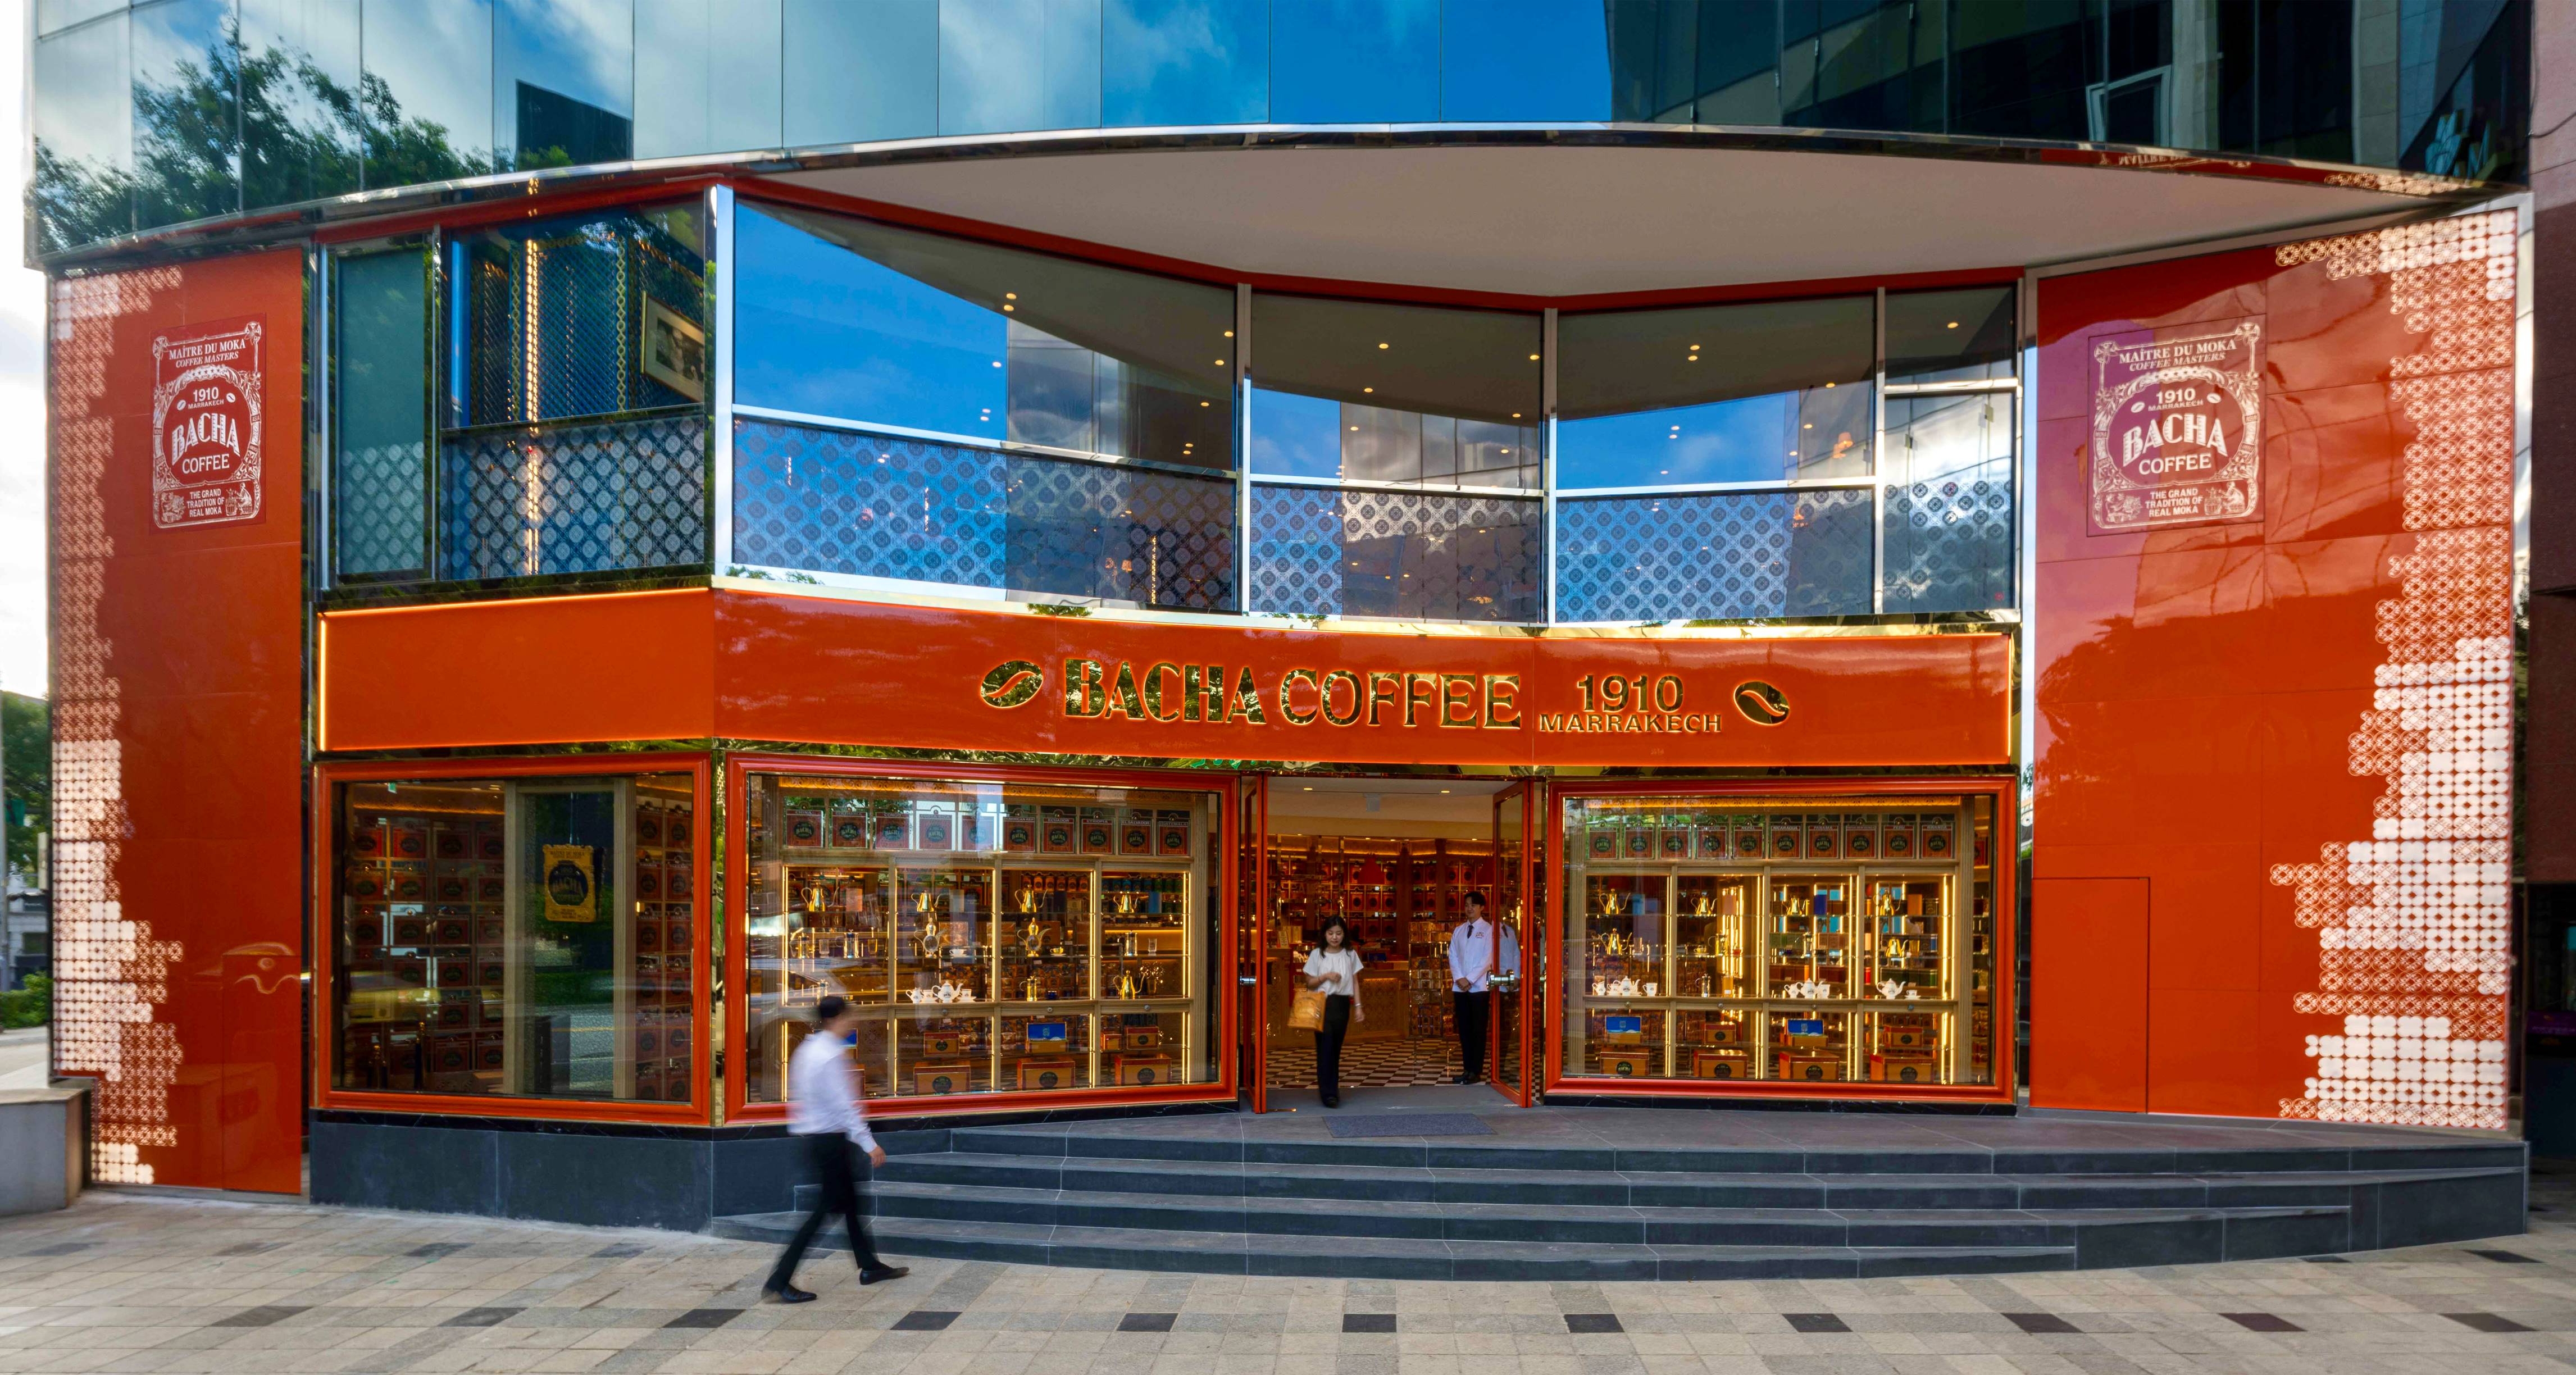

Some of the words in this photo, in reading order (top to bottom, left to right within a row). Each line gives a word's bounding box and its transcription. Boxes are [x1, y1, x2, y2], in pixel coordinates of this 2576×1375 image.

[205, 342, 217, 354] DU
[220, 339, 246, 352] MOKA
[2174, 344, 2193, 356] DU
[2197, 339, 2237, 354] MOKA
[176, 356, 203, 368] COFFEE
[203, 352, 239, 366] MASTERS
[2129, 359, 2171, 371] COFFEE
[2172, 352, 2226, 366] MASTERS
[193, 386, 219, 402] 1910
[2156, 388, 2196, 404] 1910
[188, 399, 224, 409] MARRAKECH
[2148, 400, 2204, 411] MARRAKECH
[171, 413, 240, 466] BACHA
[2123, 413, 2228, 467] BACHA
[182, 453, 230, 473] COFFEE
[2138, 453, 2212, 475] COFFEE
[189, 490, 201, 499] THE
[202, 488, 221, 498] GRAND
[2150, 491, 2167, 500] THE
[2168, 488, 2199, 498] GRAND
[186, 498, 216, 508] TRADITION
[217, 497, 225, 506] OF
[2145, 499, 2190, 509] TRADITION
[2191, 496, 2204, 504] OF
[189, 507, 204, 517] REAL
[205, 506, 222, 516] MOKA
[2149, 508, 2171, 517] REAL
[2173, 505, 2199, 515] MOKA
[1065, 659, 1267, 725] BACHA
[1280, 668, 1521, 730] COFFEE
[1577, 674, 1684, 713] 1910
[1539, 713, 1722, 733] MARRAKECH
